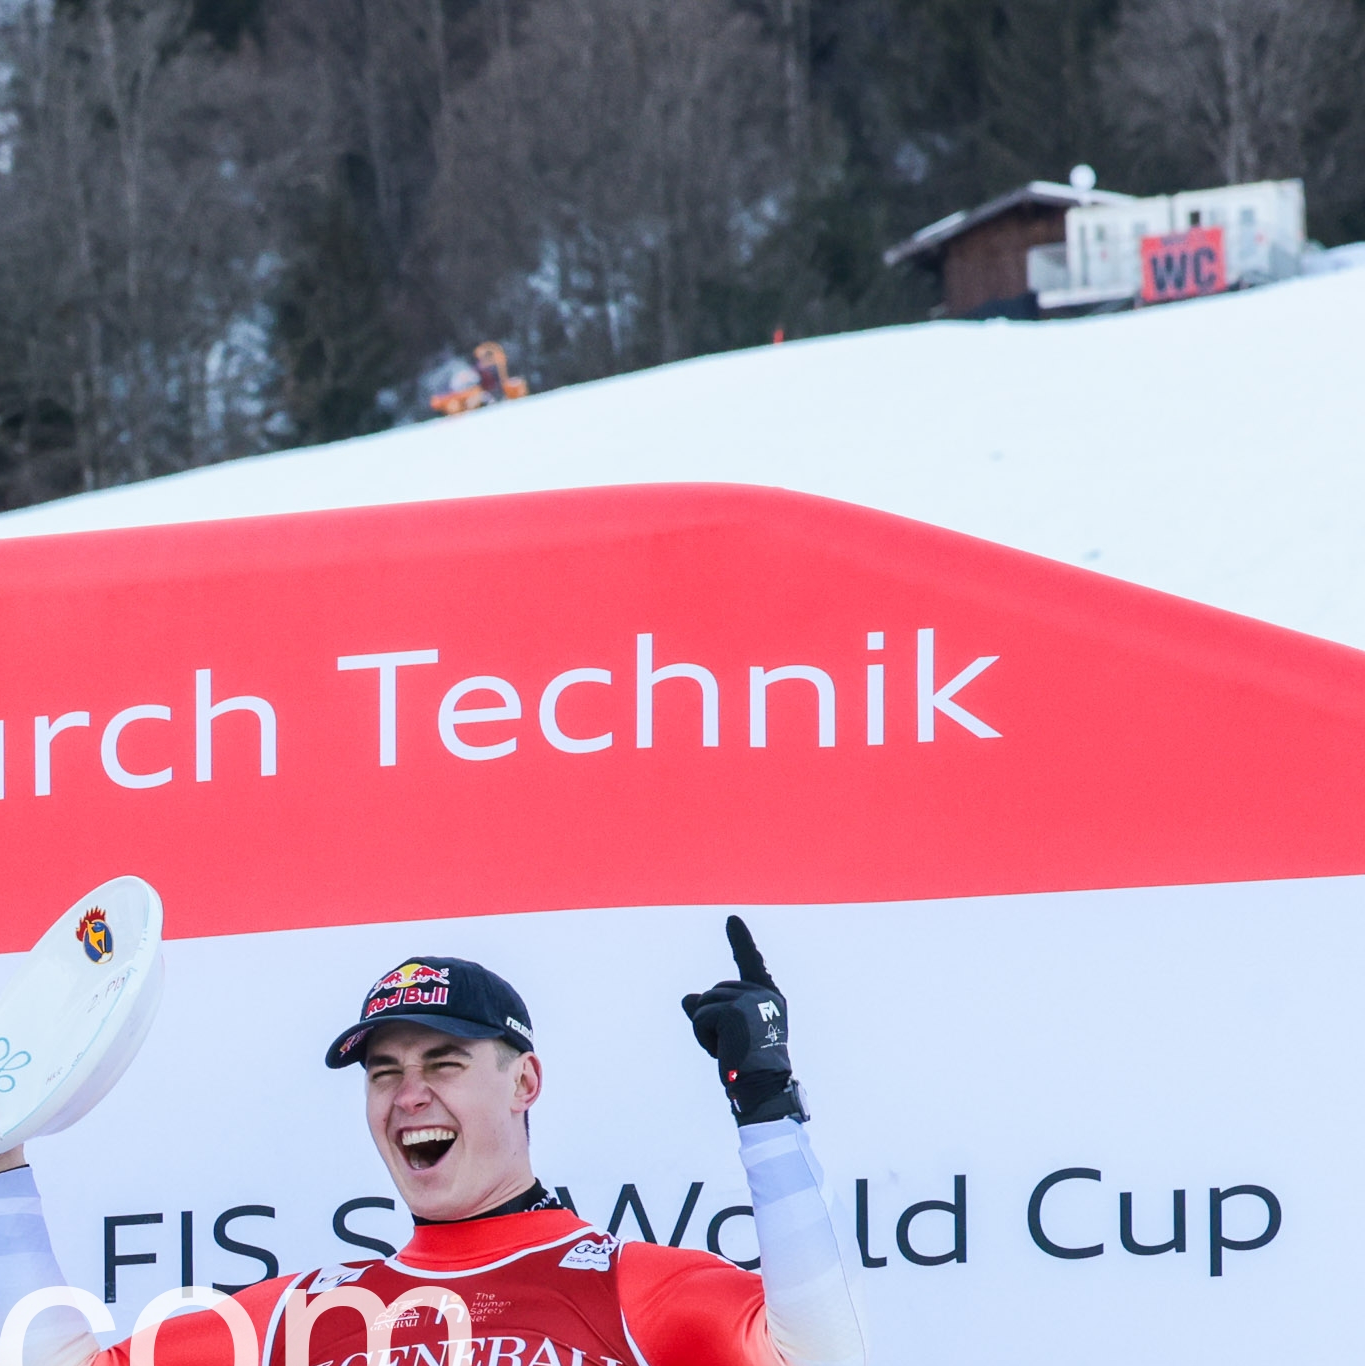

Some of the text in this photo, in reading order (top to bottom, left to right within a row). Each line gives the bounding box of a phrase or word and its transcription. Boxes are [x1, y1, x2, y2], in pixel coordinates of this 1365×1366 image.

[1151, 248, 1215, 292] WC
[337, 627, 1003, 767] Technik
[365, 986, 448, 1019] Red Bull
[103, 1204, 281, 1304] FIS
[1027, 1167, 1283, 1277] Cup
